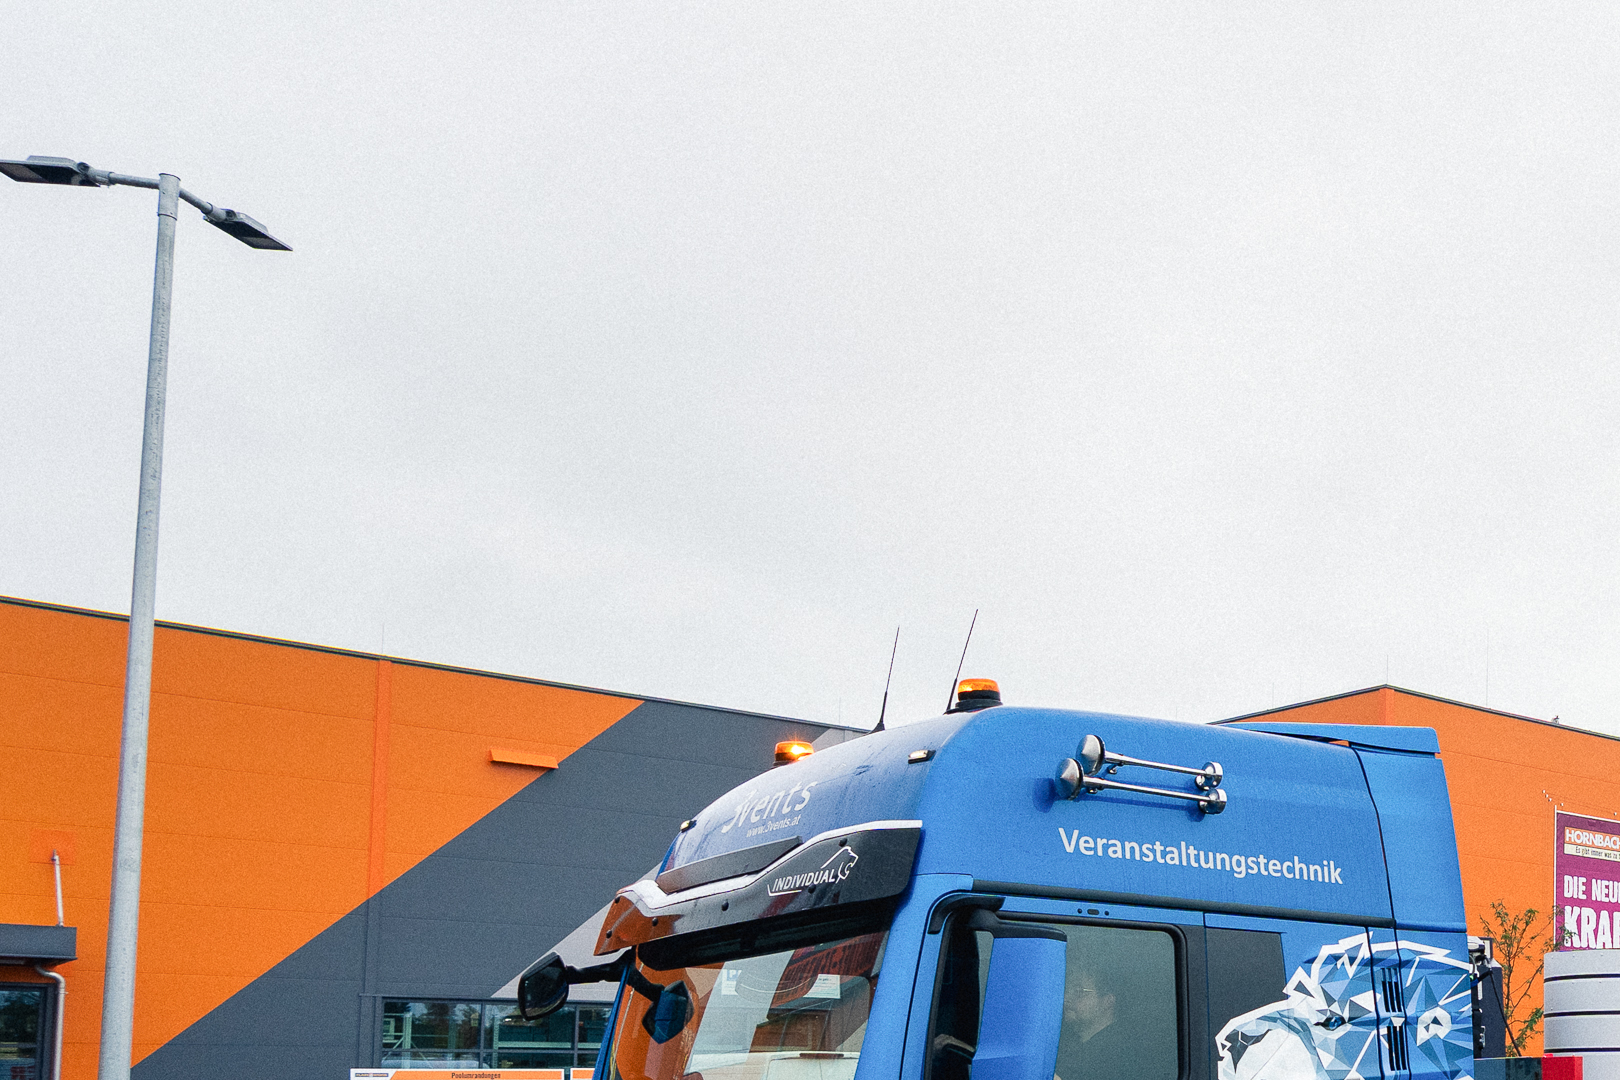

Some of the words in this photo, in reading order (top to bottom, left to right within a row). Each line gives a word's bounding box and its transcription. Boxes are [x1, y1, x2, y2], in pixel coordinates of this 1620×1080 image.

[721, 781, 817, 833] 3vents
[746, 814, 802, 838] www.3vents.at
[1058, 827, 1343, 885] Veranstaltungstechnik
[772, 869, 836, 892] INDIVIDUAL
[1564, 874, 1587, 900] DIE
